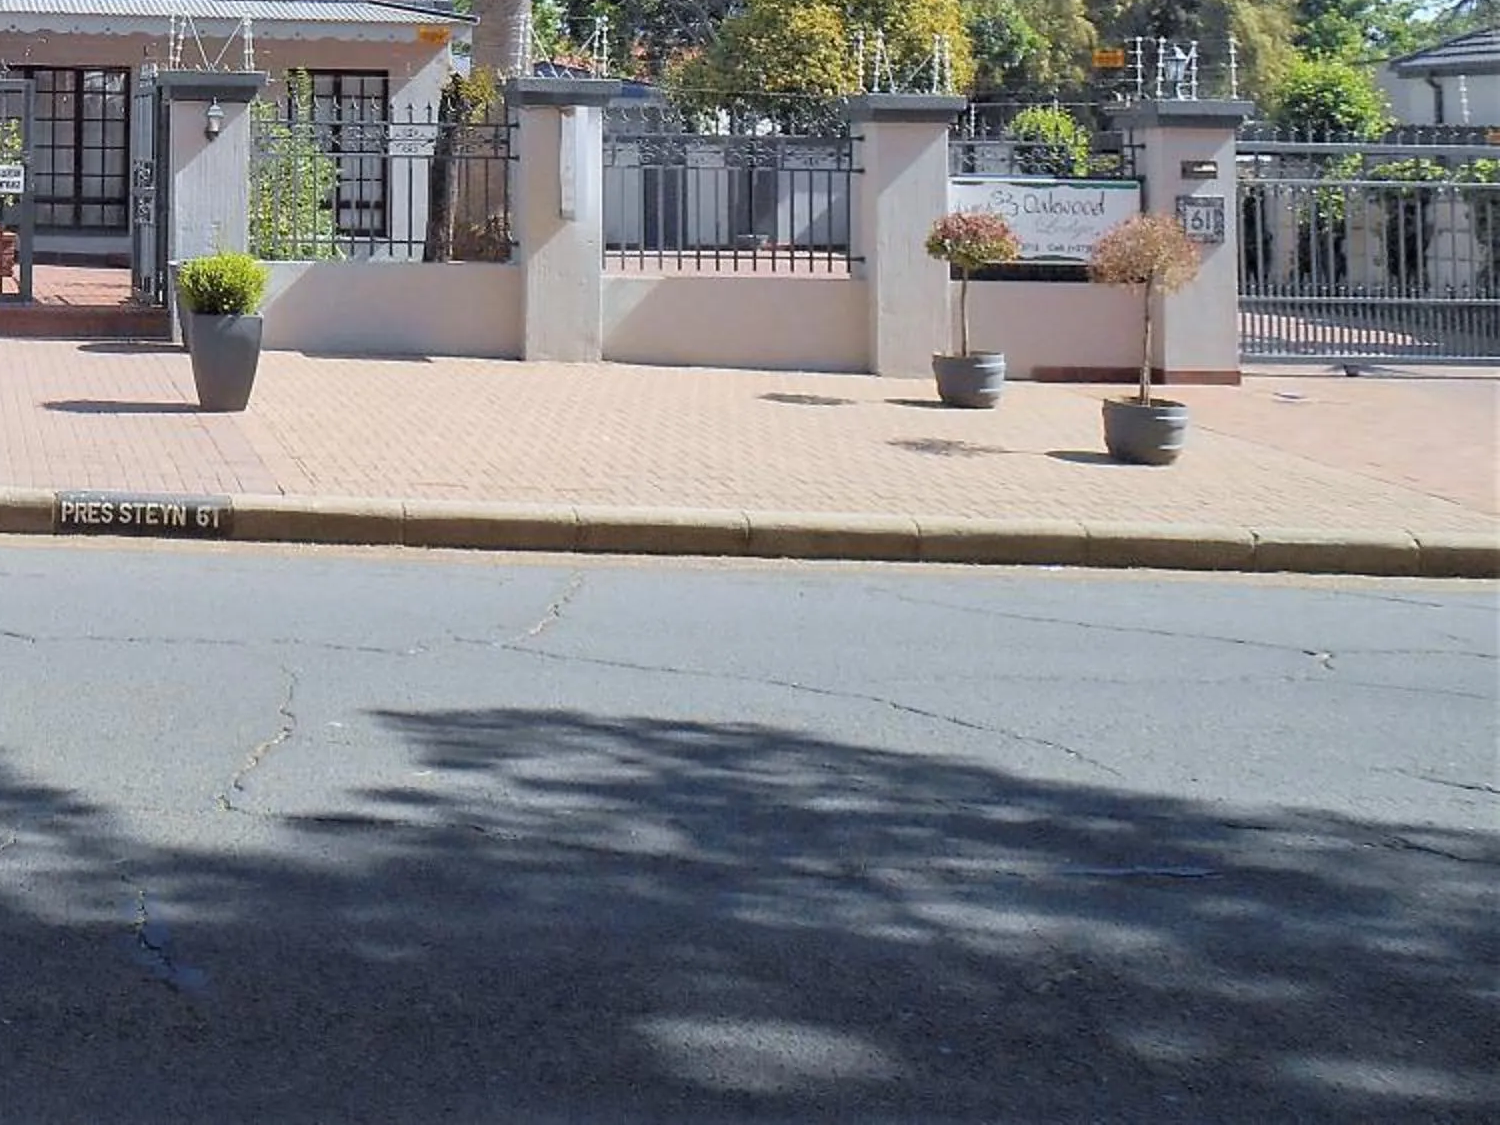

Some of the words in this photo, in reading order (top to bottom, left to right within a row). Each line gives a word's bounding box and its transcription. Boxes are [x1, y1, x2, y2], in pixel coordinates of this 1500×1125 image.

[1191, 208, 1211, 230] 61
[61, 501, 114, 524] PRES
[119, 502, 186, 526] STEYN
[195, 506, 220, 528] 61
